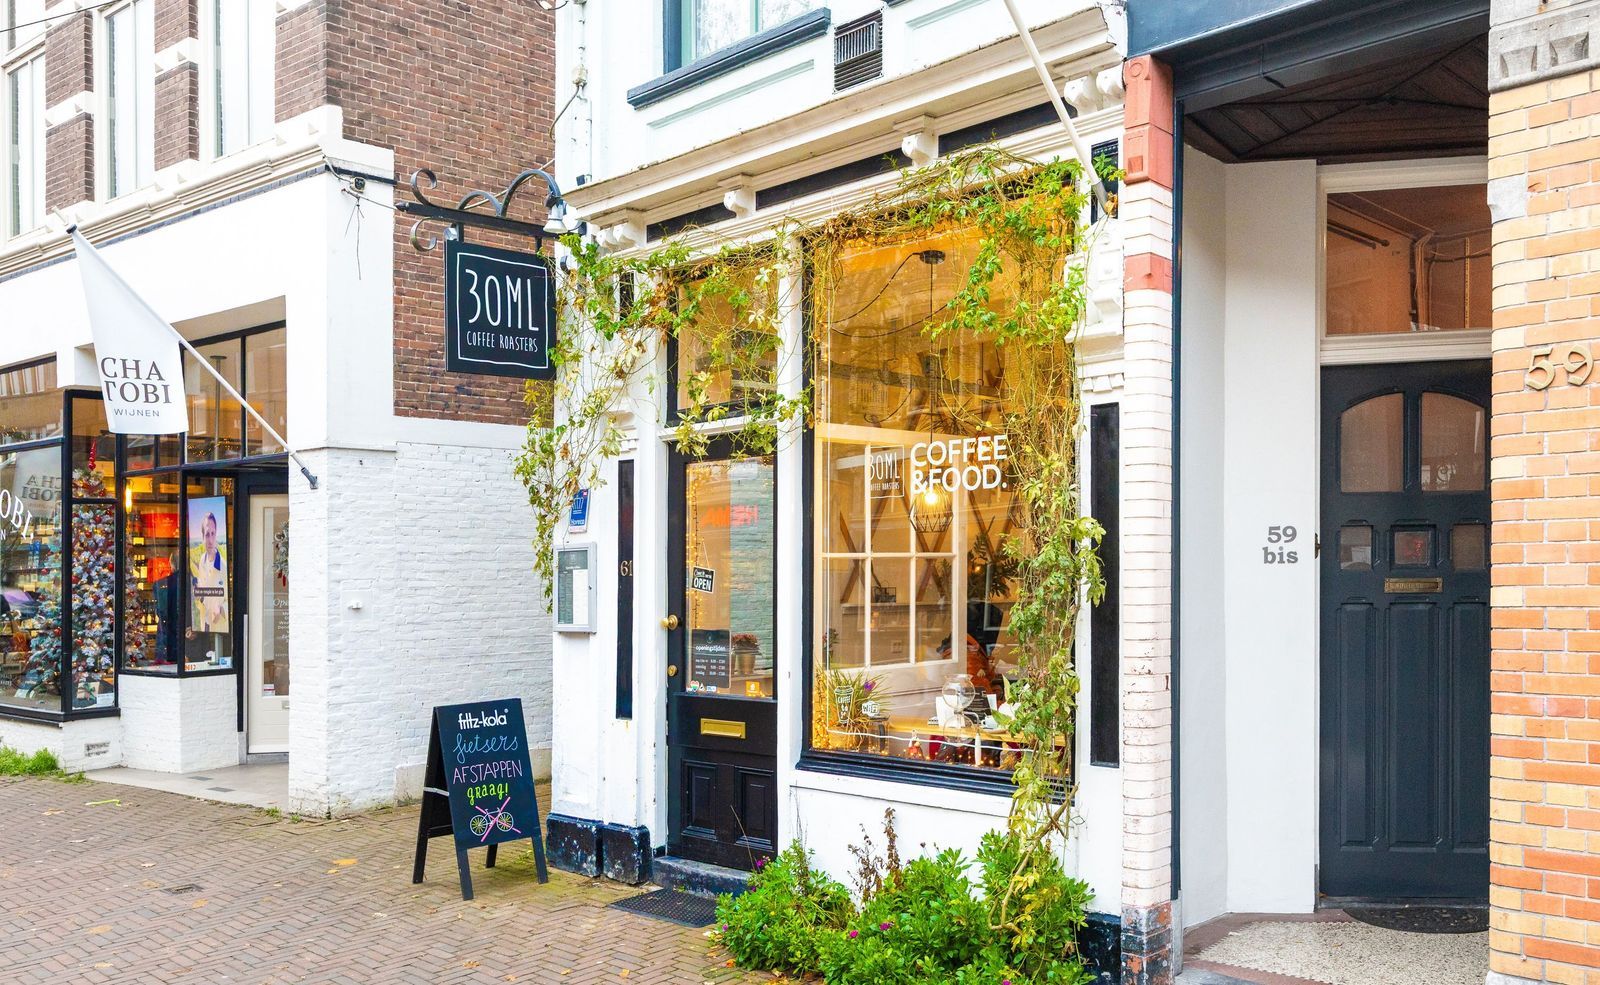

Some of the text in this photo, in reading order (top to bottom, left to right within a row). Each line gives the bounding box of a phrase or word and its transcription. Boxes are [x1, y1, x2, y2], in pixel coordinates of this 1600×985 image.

[465, 269, 539, 331] 30ML
[466, 331, 538, 353] COFFEE ROASTERS
[101, 357, 166, 381] CHA
[1525, 345, 1594, 391] 59
[114, 408, 160, 417] WIJNEN
[910, 435, 1008, 467] COFFEE
[911, 464, 1008, 494] &FOOD.
[1267, 526, 1297, 543] 59
[1263, 547, 1299, 564] bis
[620, 560, 633, 577] 61
[694, 577, 712, 591] OPEN
[452, 733, 519, 764] fietsers
[453, 760, 523, 785] AFSTAPPEN
